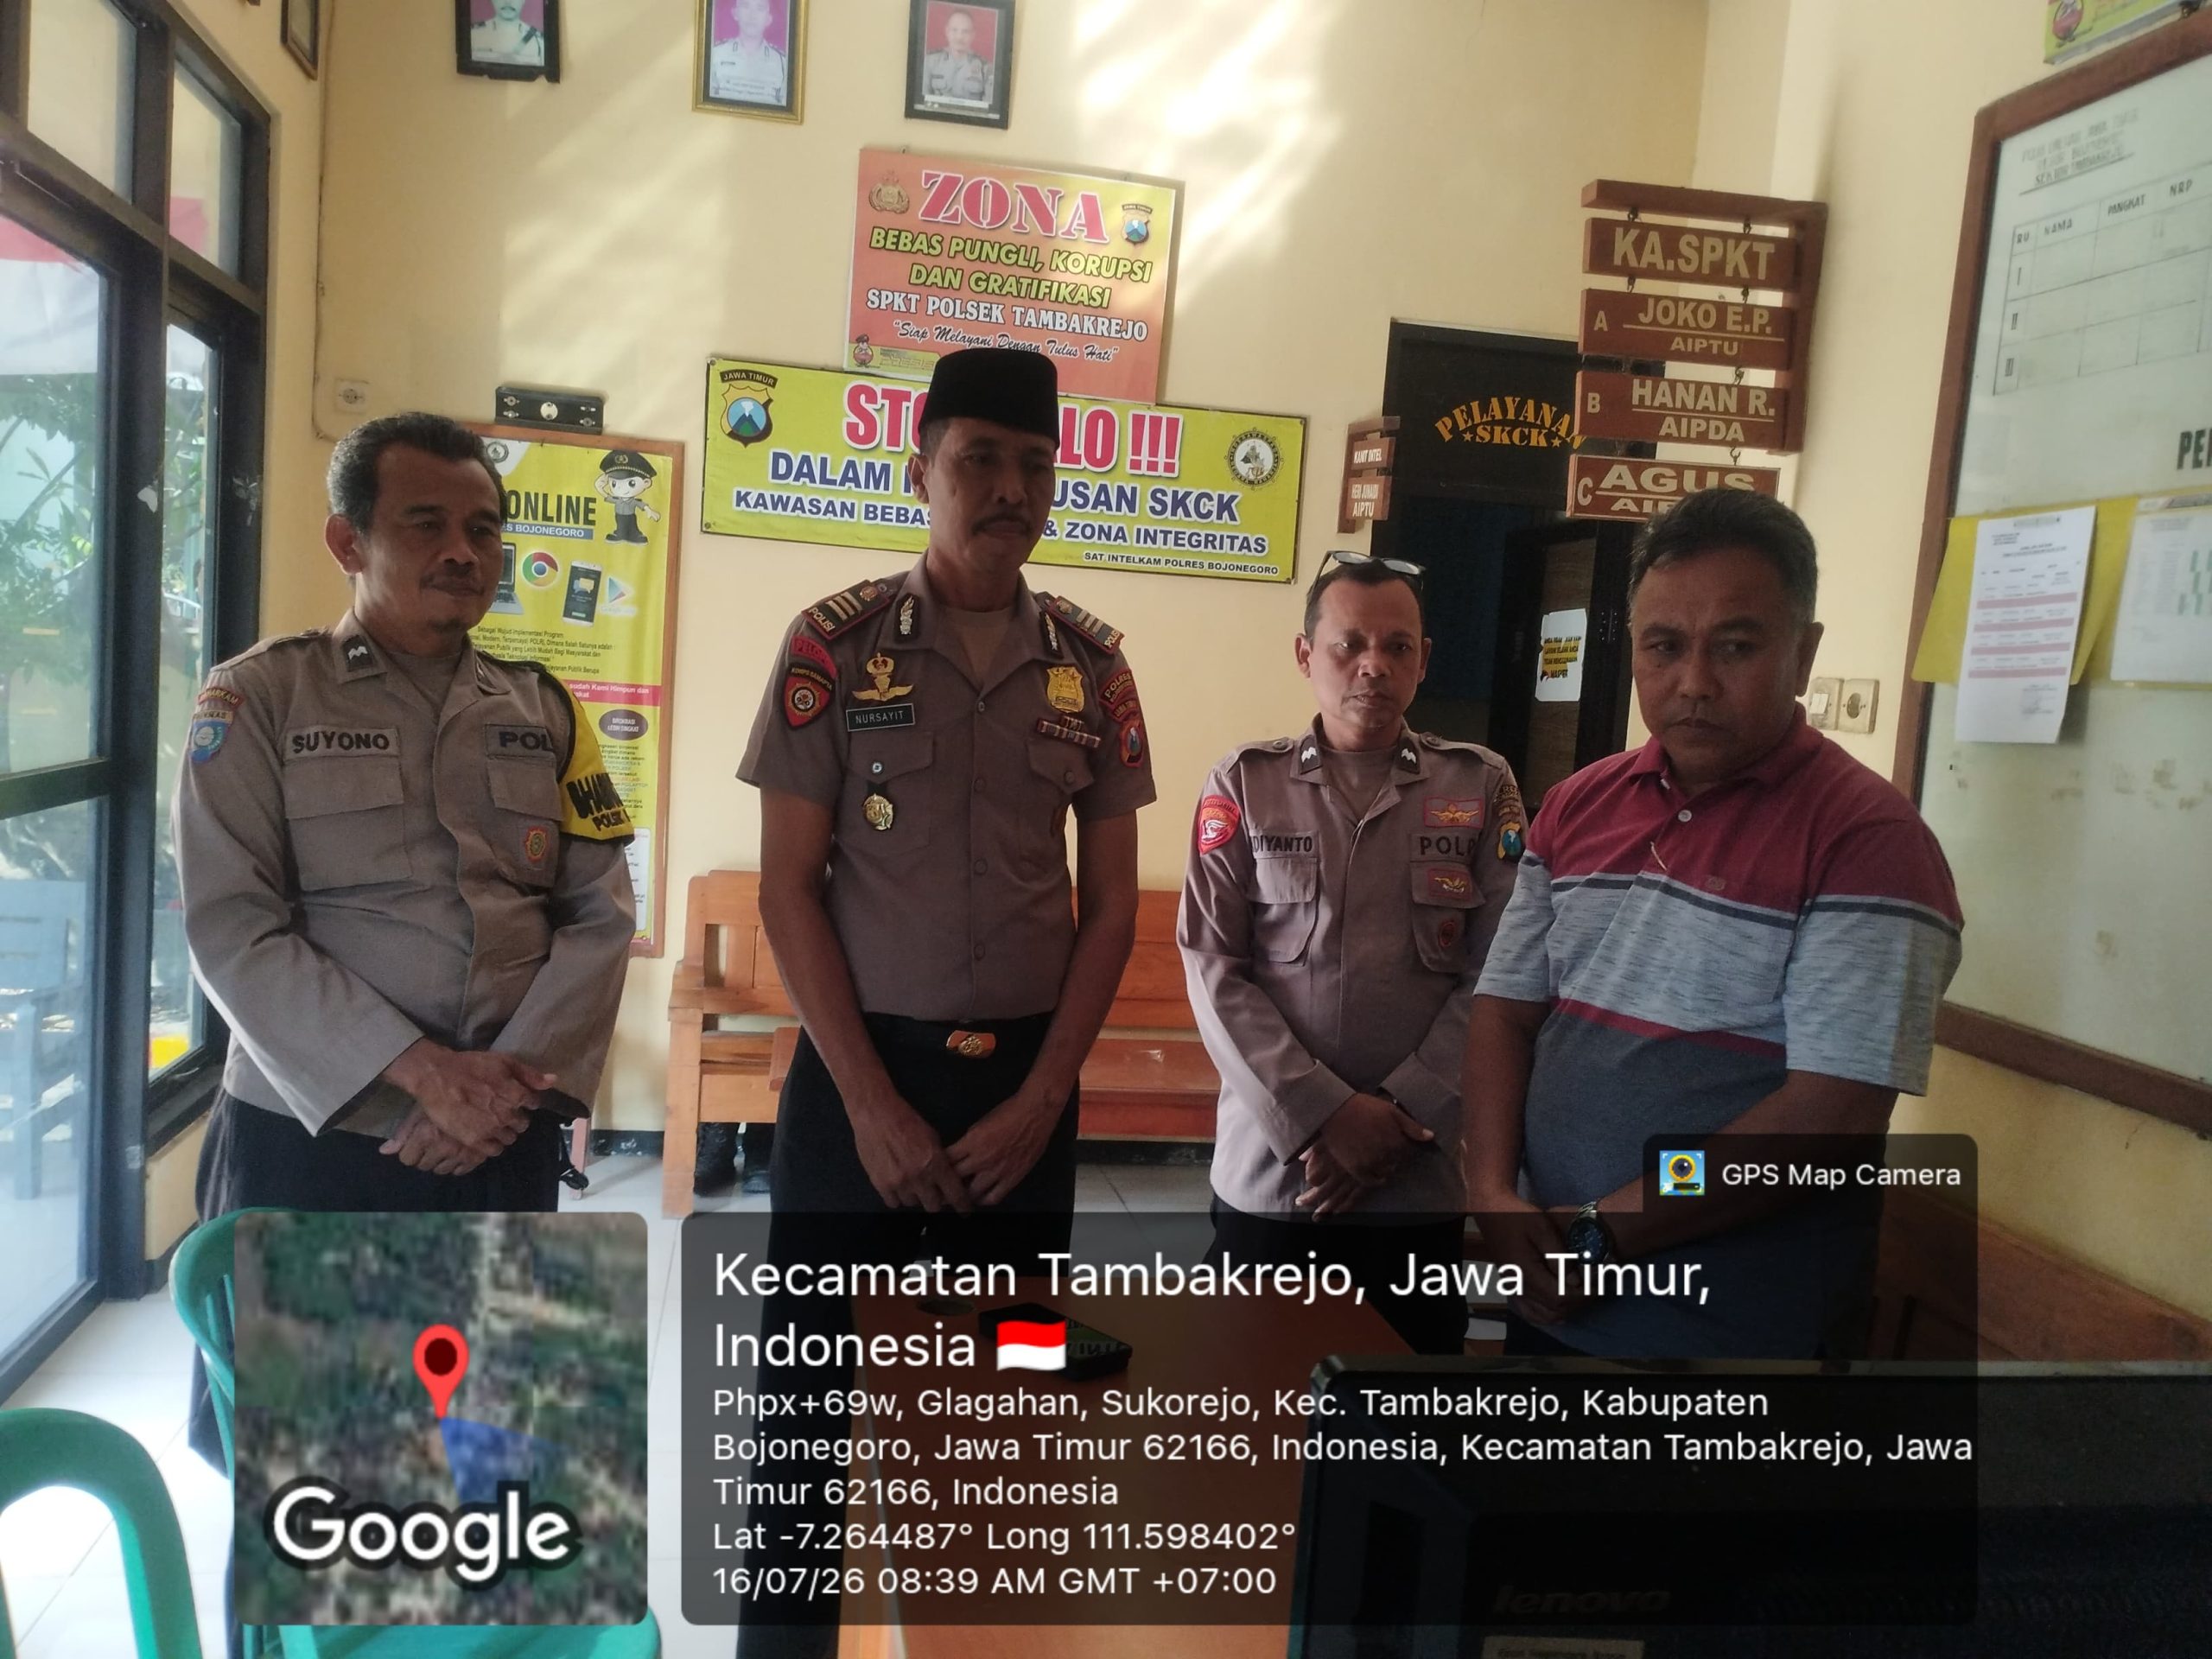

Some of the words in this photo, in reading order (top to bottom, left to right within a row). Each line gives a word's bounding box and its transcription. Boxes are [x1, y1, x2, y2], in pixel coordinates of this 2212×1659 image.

[918, 169, 1109, 244] ZONA
[2044, 219, 2073, 235] NAMA
[2108, 194, 2146, 215] PANGKAT
[2170, 179, 2193, 196] NRP
[869, 227, 944, 257] BEBAS
[949, 237, 1044, 272] PUNGLI,
[1050, 248, 1153, 283] KORUPSI
[1613, 227, 1775, 280] KA.SPKT
[910, 264, 963, 290] DAN
[969, 270, 1111, 308] GRATIFIKASI
[867, 289, 919, 314] SPKT
[927, 296, 1006, 325] POLSEK
[1012, 305, 1148, 341] TAMBAKREJO
[1594, 311, 1608, 332] A
[1638, 297, 1717, 329] JOKO
[1726, 306, 1772, 334] E.P.
[933, 327, 993, 348] Melayani
[997, 334, 1041, 353] Dengan
[1046, 339, 1078, 359] Tulus
[1670, 337, 1738, 355] AIPTU
[723, 372, 747, 380] JAWA
[748, 372, 775, 386] TIMUR
[1587, 392, 1600, 413] B
[1632, 378, 1738, 413] HANAN
[1748, 390, 1775, 416] R.
[845, 381, 929, 452] ST
[1054, 406, 1119, 472] LO
[1128, 410, 1184, 477] !!!
[1475, 425, 1548, 447] SKCK
[1659, 416, 1745, 442] AIPDA
[770, 451, 892, 492] DALAM
[1149, 487, 1240, 523] SKCK
[1577, 478, 1592, 505] C
[1599, 464, 1754, 492] AGUS
[507, 490, 596, 525] ONLINE
[734, 490, 855, 519] KAWASAN
[1043, 520, 1057, 537] &
[1066, 522, 1128, 543] ZONA
[1136, 527, 1267, 554] INTEGRITAS
[1352, 502, 1375, 517] AIPTU
[516, 524, 584, 537] BOJONEGORO
[1084, 552, 1104, 561] SAT
[1108, 554, 1161, 566] INTELKAM
[1165, 558, 1205, 569] POLRES
[1208, 562, 1279, 575] BOJONEGORO
[809, 607, 836, 632] POLISI
[855, 710, 904, 724] NURSAYIT
[291, 733, 390, 754] SUYONO
